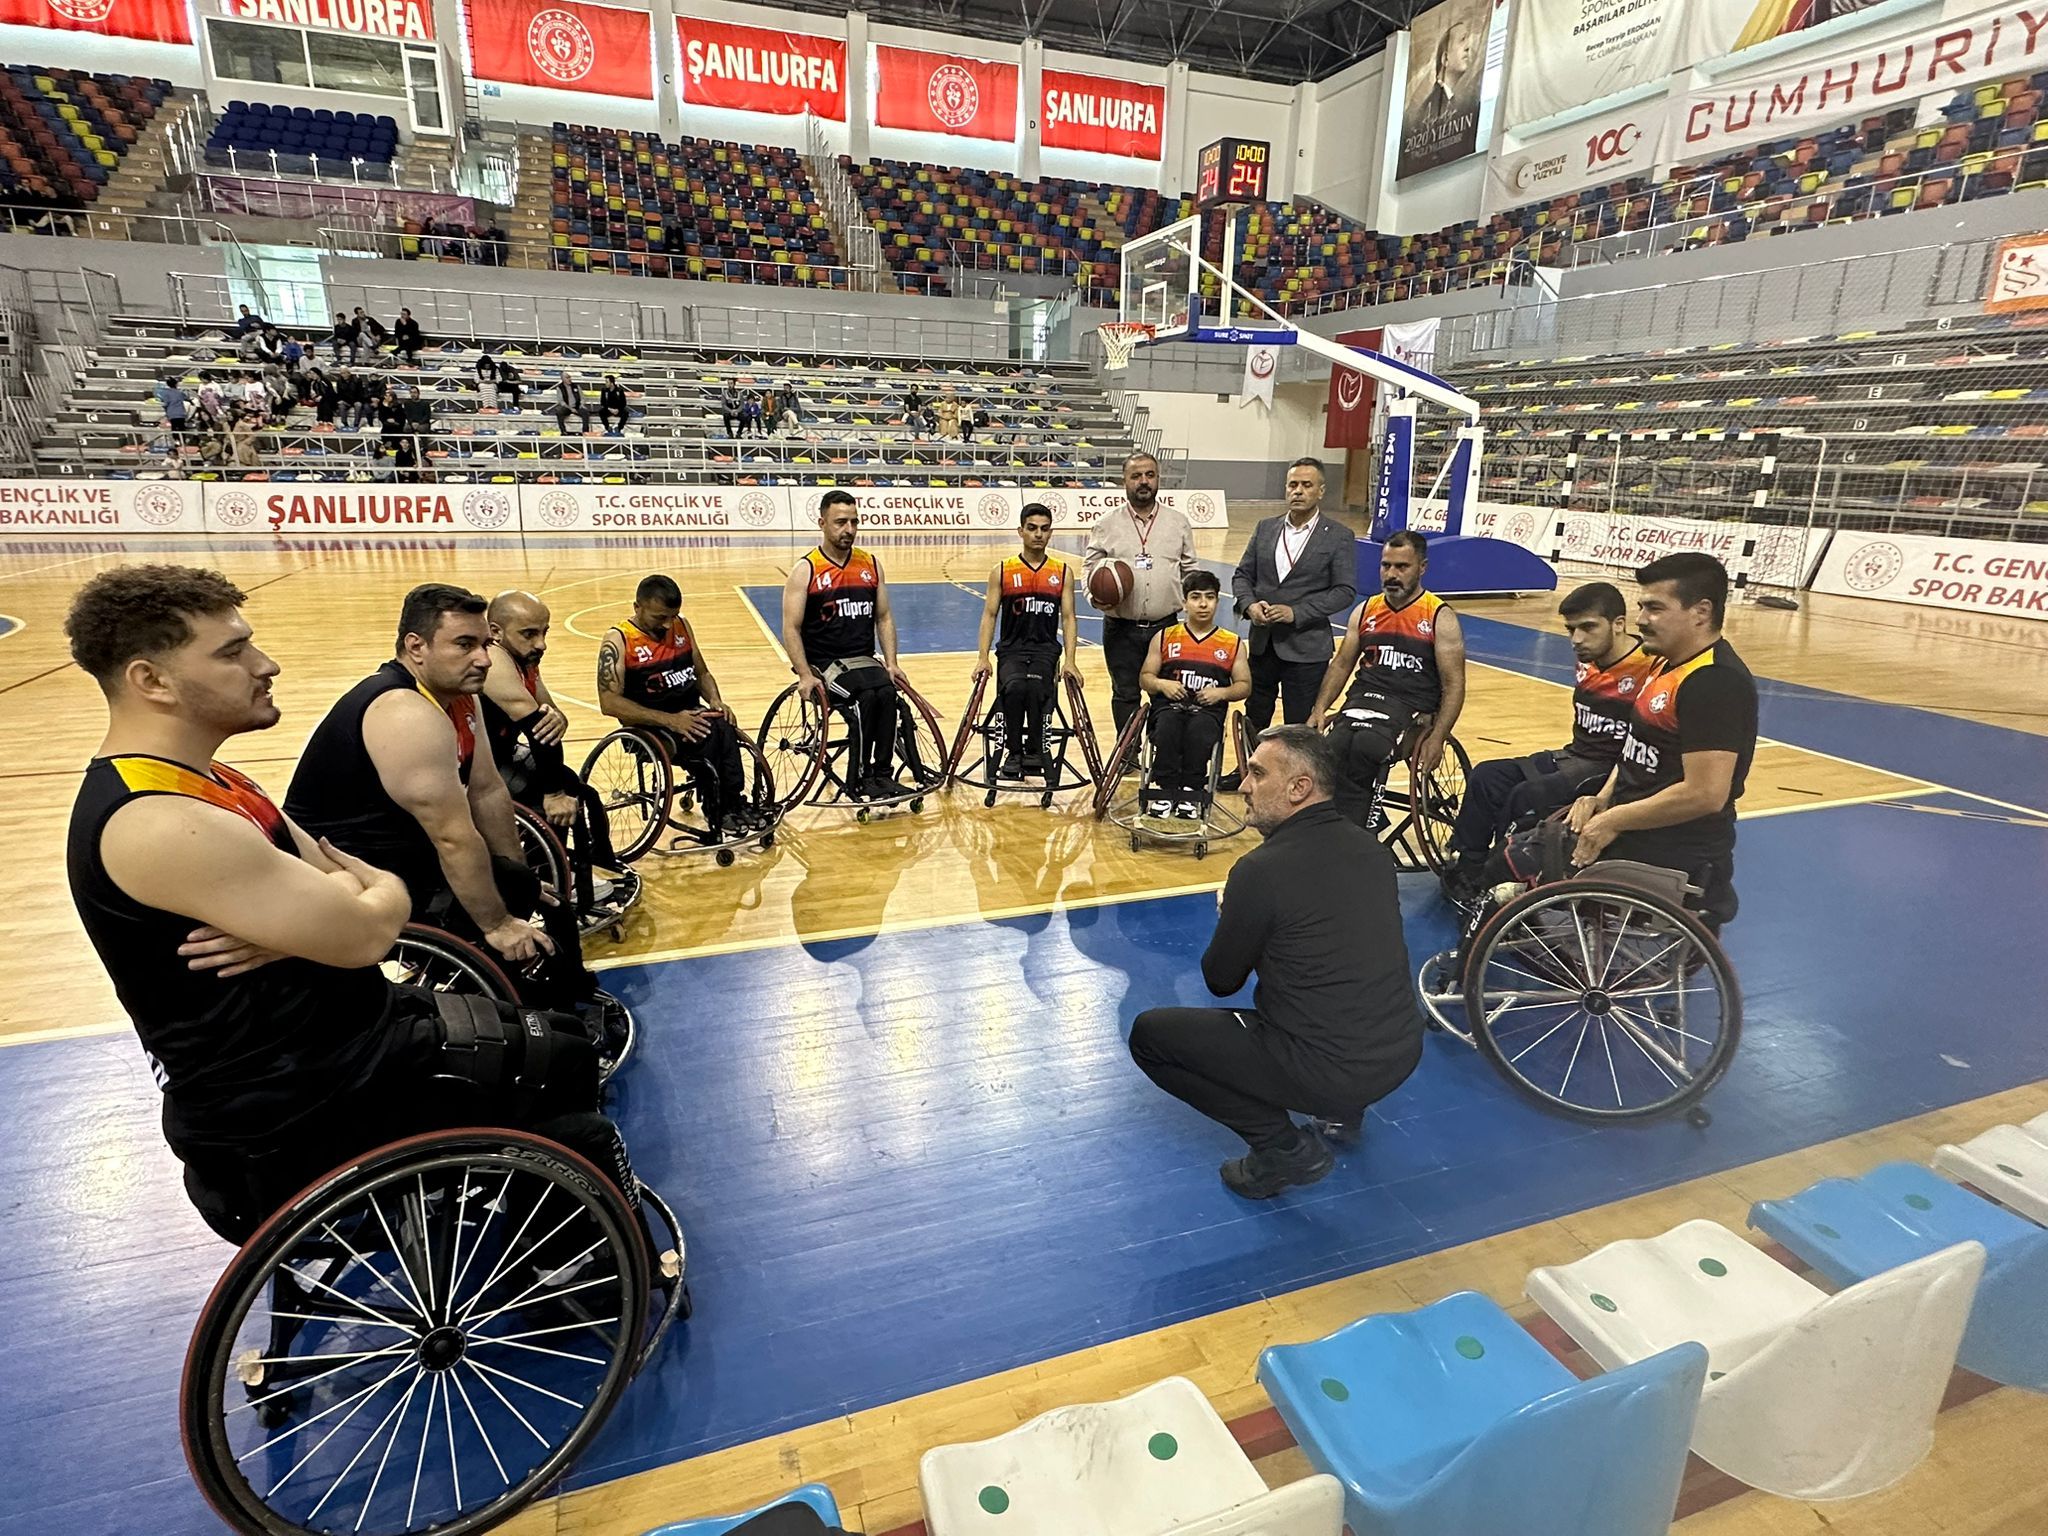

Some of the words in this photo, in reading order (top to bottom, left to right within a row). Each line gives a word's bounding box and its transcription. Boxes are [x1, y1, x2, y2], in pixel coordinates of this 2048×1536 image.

[1573, 6, 1626, 36] BAŞARILAR
[1627, 16, 1662, 36] ERDOĞAN
[687, 39, 839, 93] ŞANLIURFA
[1045, 89, 1157, 135] ŞANLIURFA
[1236, 144, 1266, 163] 10:00
[1200, 166, 1220, 202] 24
[1229, 163, 1261, 197] 24
[83, 489, 111, 503] VE
[595, 495, 625, 508] T.C.
[628, 493, 699, 511] GENÇLİK
[702, 495, 723, 508] VE
[857, 497, 880, 509] T.C.
[883, 494, 947, 511] GENÇLİK
[948, 497, 964, 508] VE
[1079, 496, 1102, 507] T.C.
[0, 507, 119, 524] BAKANLIĞI
[267, 495, 454, 531] ŞANLIURFA
[592, 513, 636, 526] SPOR
[640, 511, 729, 526] BAKANLIĞI
[894, 511, 970, 526] BAKANLIĞI
[1077, 512, 1104, 523] SPO
[1482, 513, 1497, 526] VE
[1608, 526, 1631, 542] T.C.
[1635, 527, 1712, 550] GENÇLİK
[1712, 535, 1735, 550] VE
[1591, 544, 1632, 562] SPOR
[1933, 552, 1976, 573] T.C.
[1983, 557, 2048, 582] GEN
[816, 571, 832, 590] 14
[1012, 573, 1022, 588] 11
[1908, 578, 1983, 602] SPOR
[1985, 586, 2048, 612] BAK
[1168, 642, 1182, 658] 12
[995, 711, 1004, 751] EXTRA
[501, 1146, 600, 1197] SPINERGY
